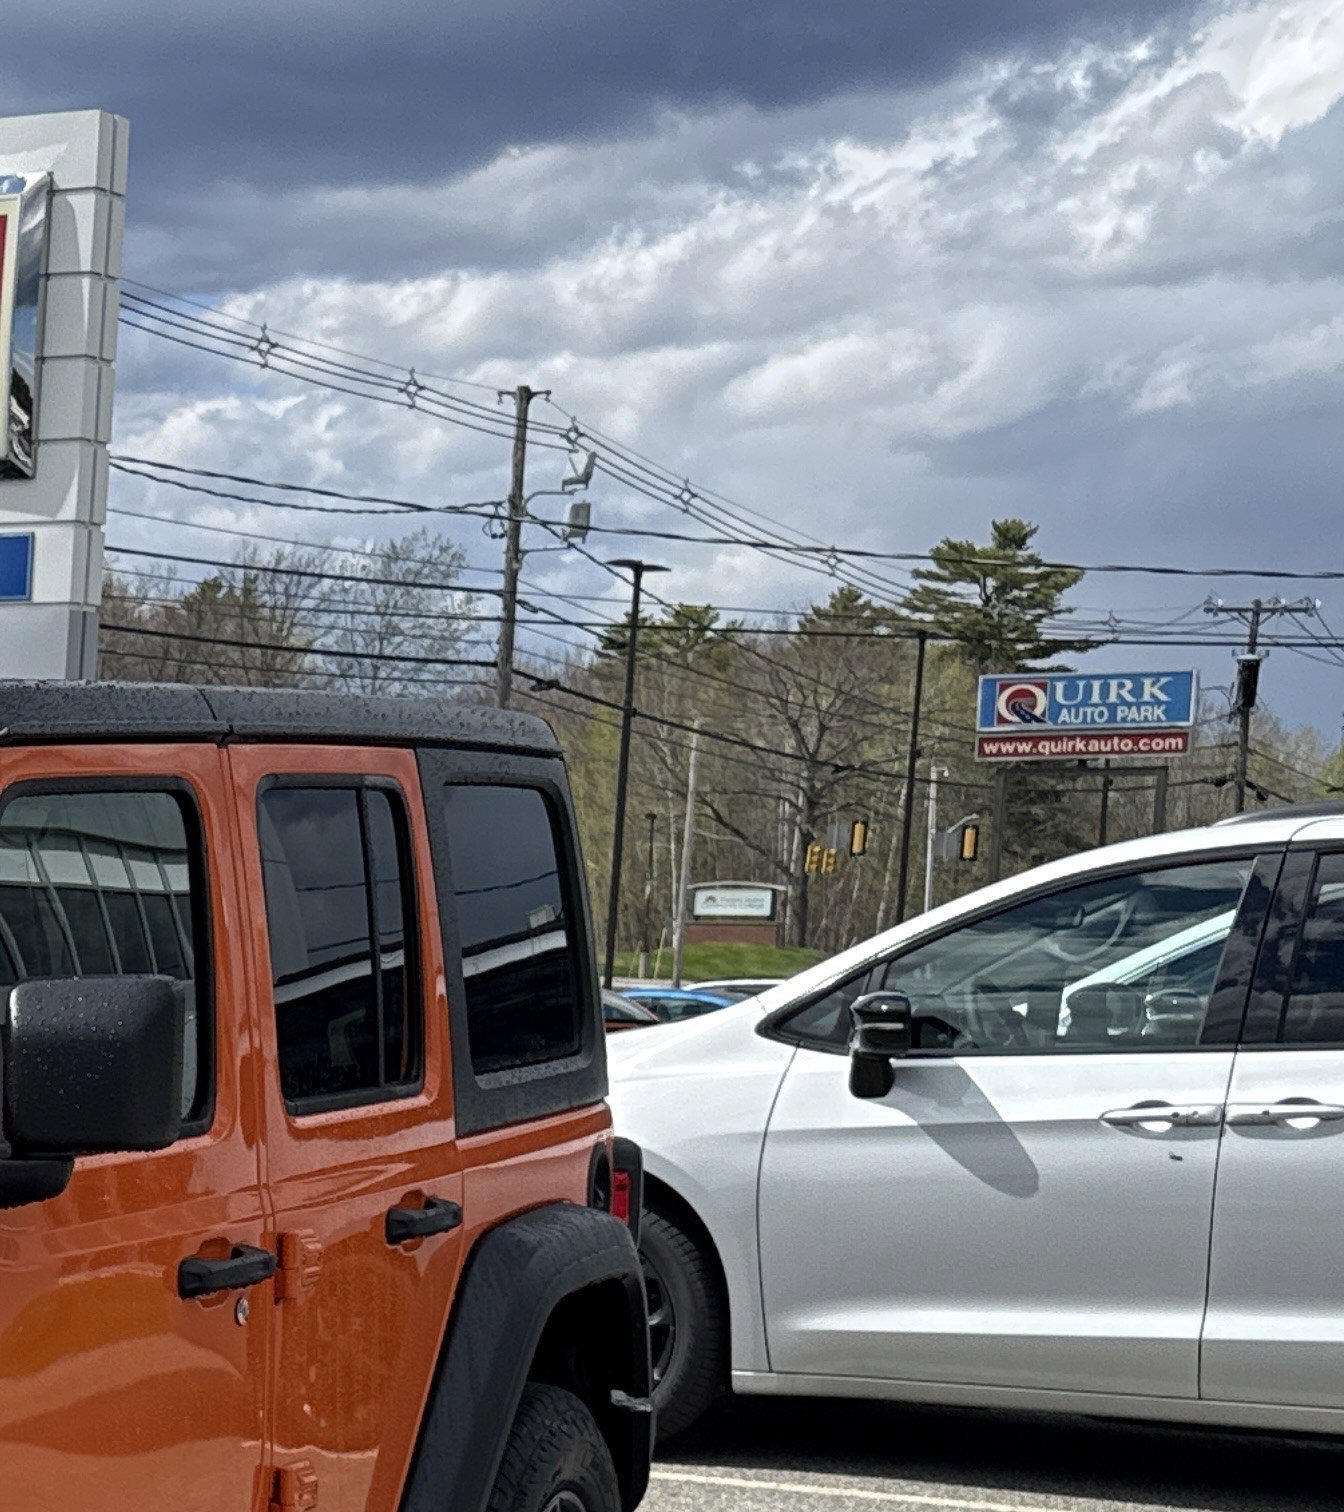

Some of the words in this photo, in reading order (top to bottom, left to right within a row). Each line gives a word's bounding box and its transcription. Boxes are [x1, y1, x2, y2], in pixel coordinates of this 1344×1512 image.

[997, 676, 1173, 725] QUIRK
[1058, 706, 1109, 724] AUTO
[1116, 704, 1167, 722] PARK
[983, 734, 1184, 755] www.quirkauto.com
